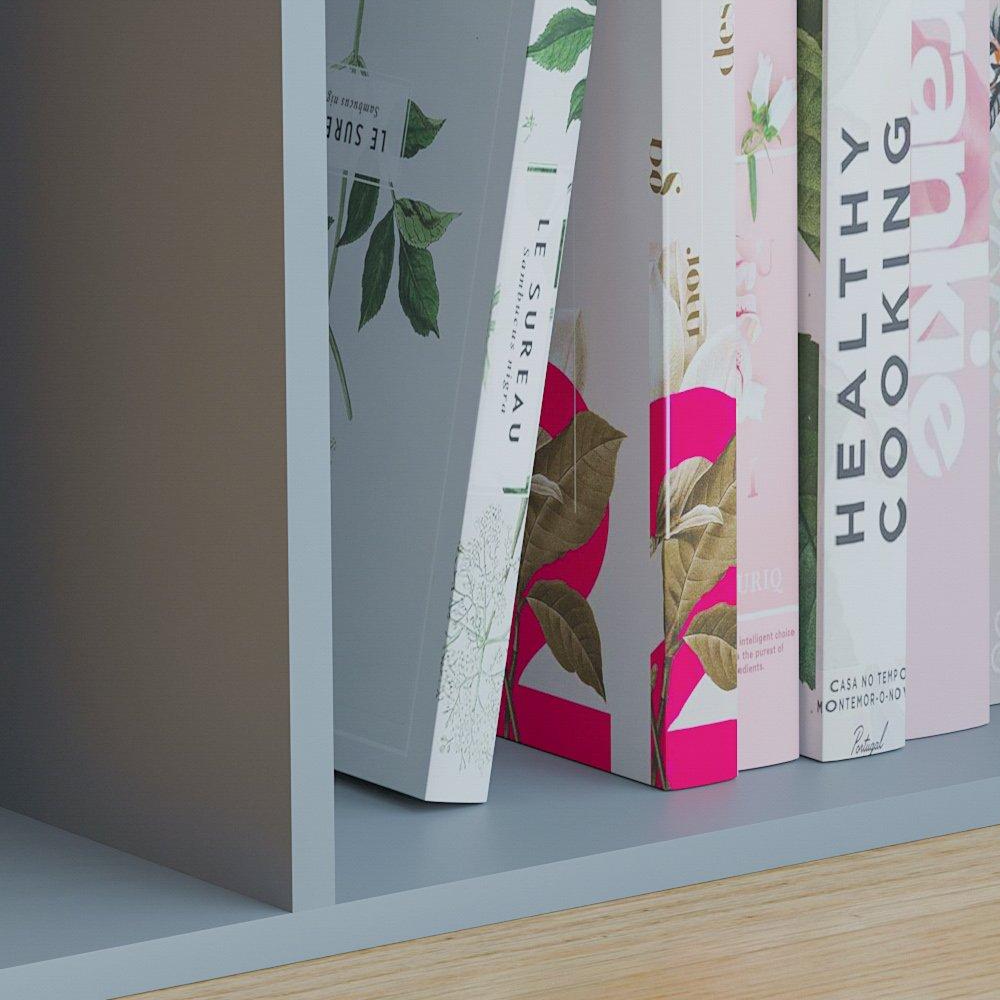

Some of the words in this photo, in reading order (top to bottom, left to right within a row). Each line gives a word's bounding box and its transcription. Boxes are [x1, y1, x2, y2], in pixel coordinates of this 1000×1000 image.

[713, 3, 734, 76] des
[341, 97, 379, 118] Sambucus
[369, 127, 387, 153] LE
[534, 218, 550, 258] LE
[509, 247, 530, 351] Sambucus
[835, 127, 869, 546] HEALTHY
[879, 116, 911, 543] COOKING
[508, 282, 541, 443] SUREAU
[501, 359, 513, 415] nigra
[739, 632, 774, 646] intelligent
[775, 627, 796, 639] choice
[742, 649, 753, 660] the
[755, 645, 776, 659] purest
[777, 643, 784, 653] of
[830, 679, 858, 693] CASA
[861, 674, 874, 688] NO
[850, 720, 889, 757] Portugal
